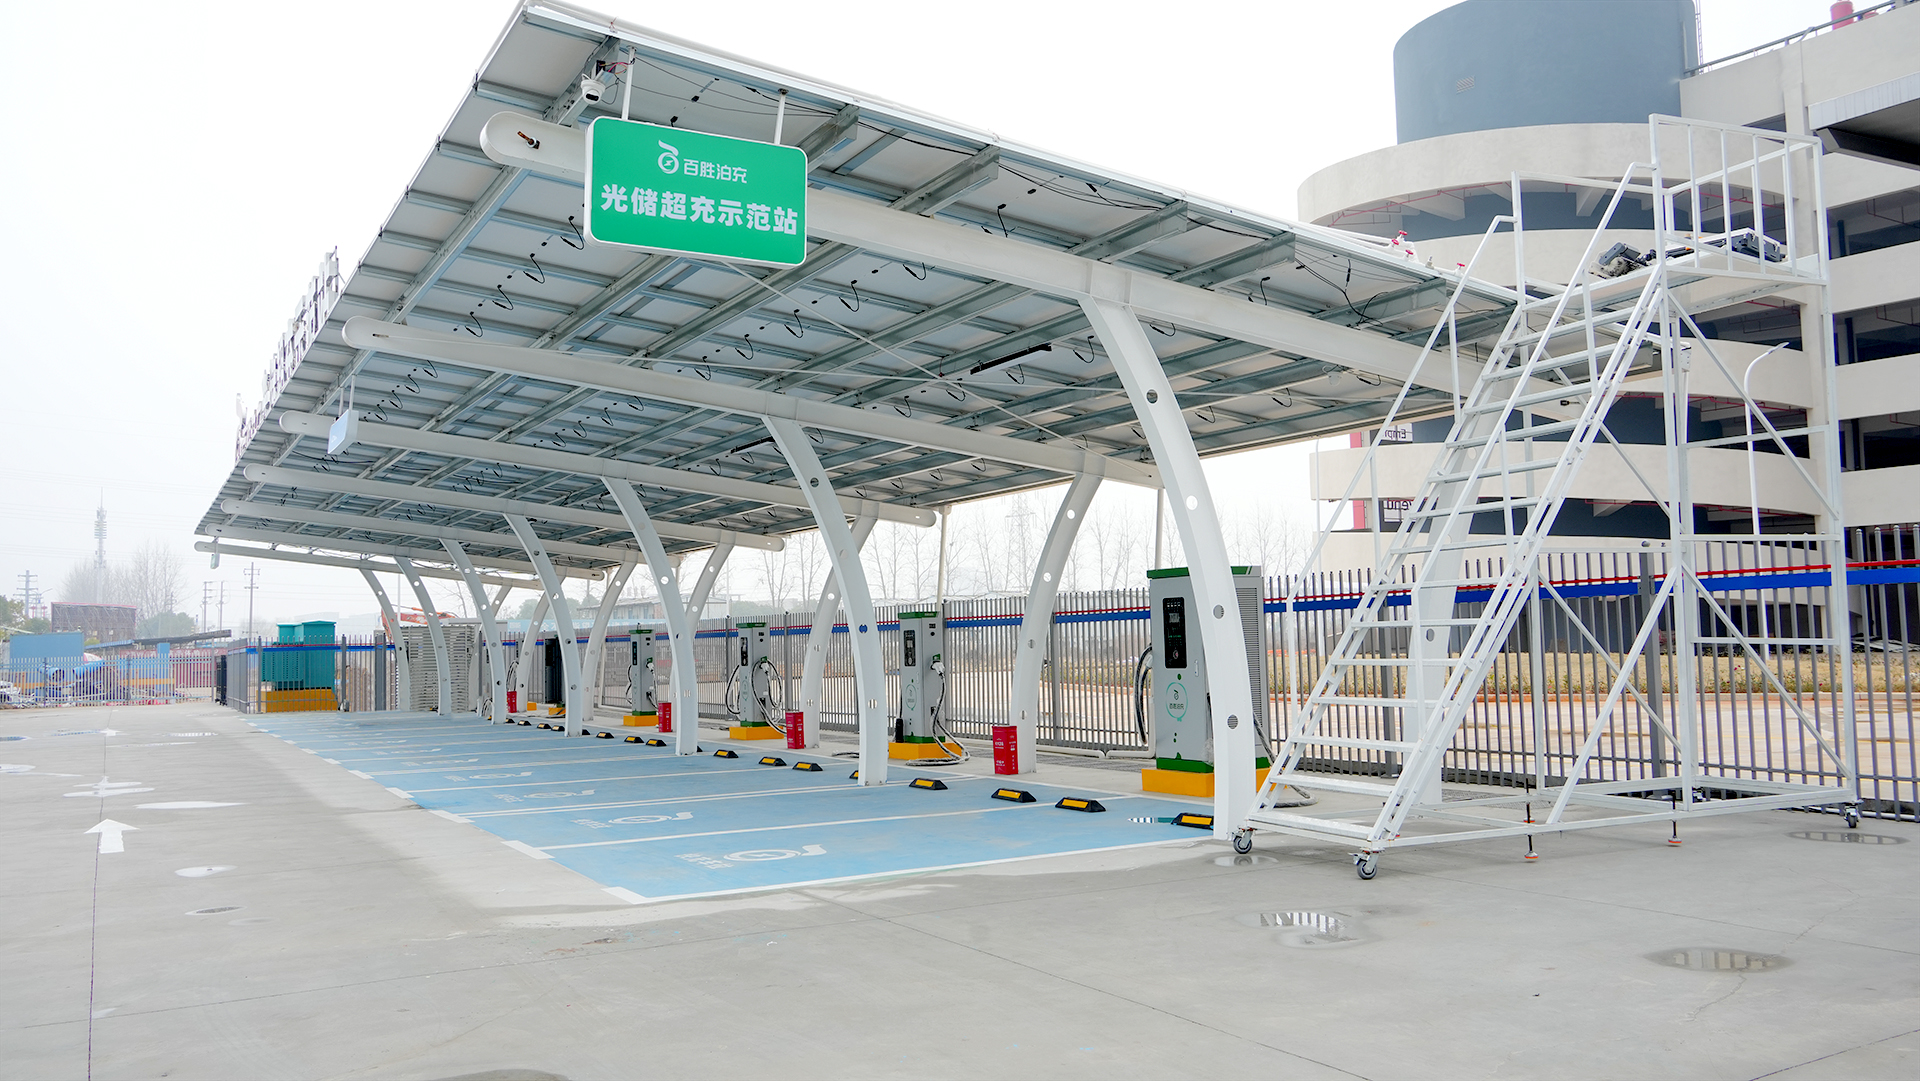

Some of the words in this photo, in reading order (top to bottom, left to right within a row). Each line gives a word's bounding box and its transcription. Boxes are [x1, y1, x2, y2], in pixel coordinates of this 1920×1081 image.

[683, 158, 748, 184] 百胜泊充
[601, 183, 798, 236] 光储超充示范站
